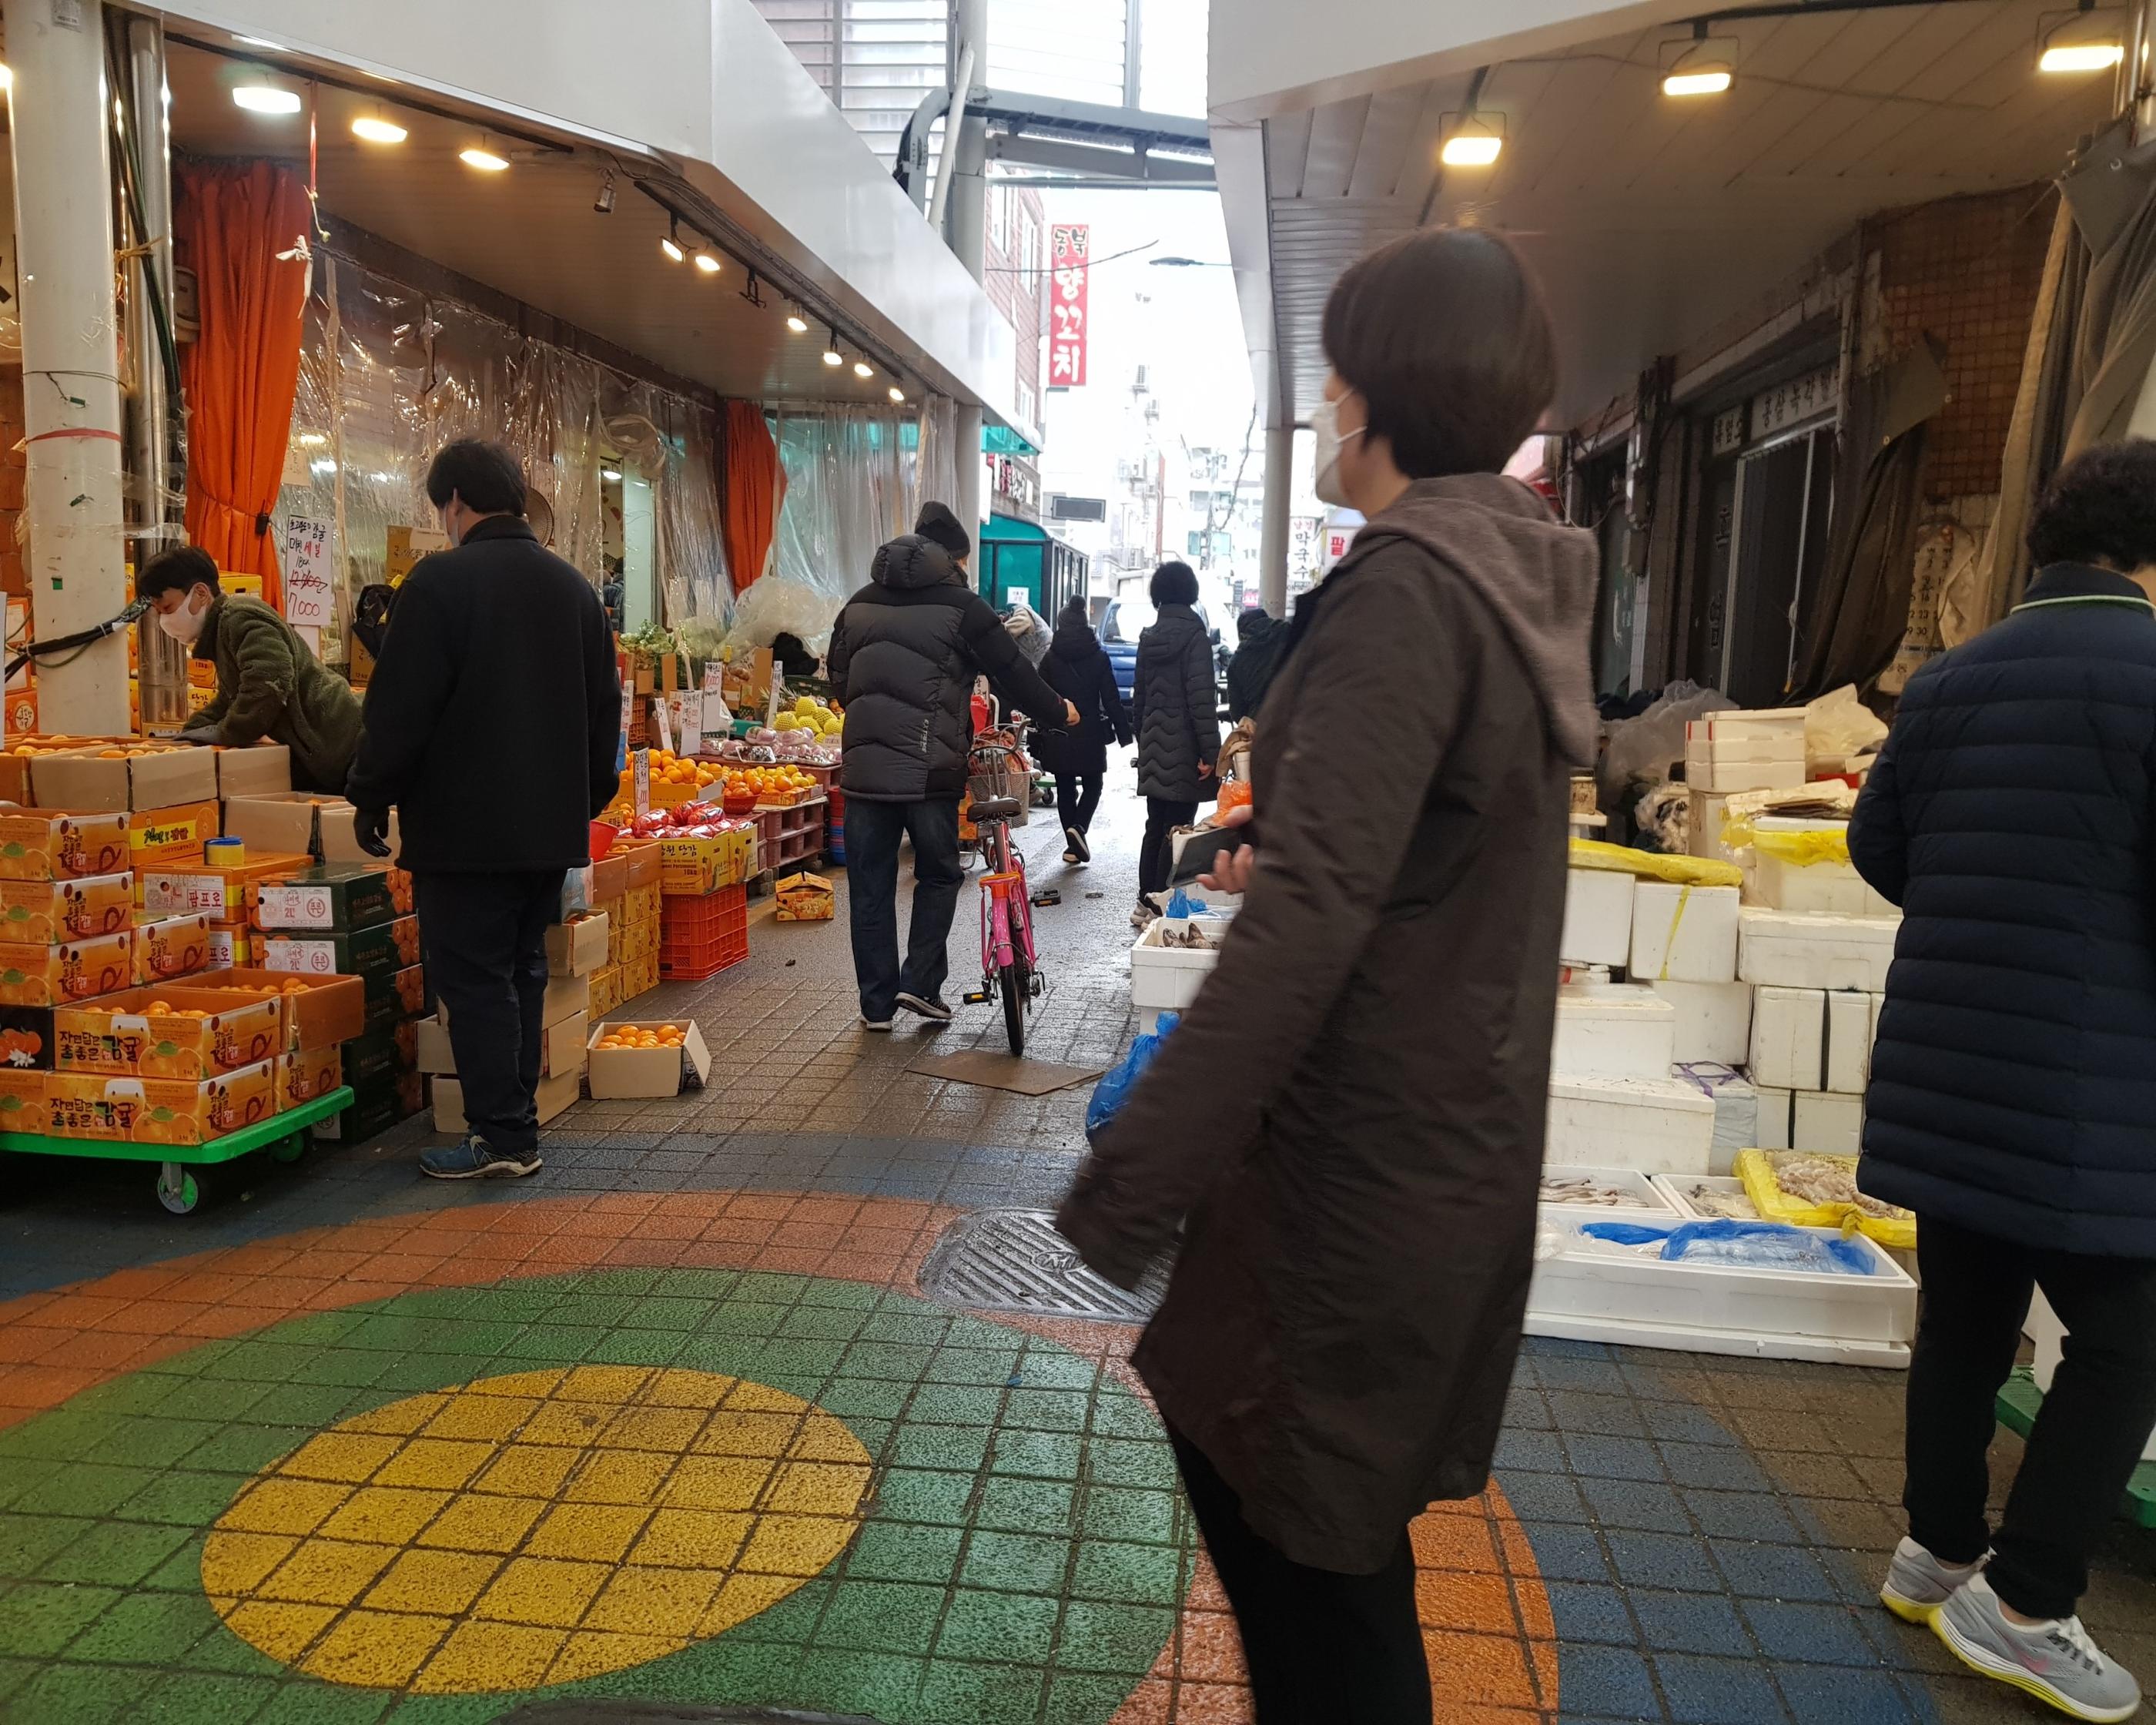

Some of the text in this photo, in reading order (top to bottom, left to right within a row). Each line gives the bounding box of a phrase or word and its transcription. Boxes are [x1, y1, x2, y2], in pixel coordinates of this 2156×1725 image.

[1054, 228, 1086, 256] 동북
[1053, 262, 1085, 384] 양꼬치
[303, 540, 320, 558] 세일
[1293, 531, 1311, 581] 막국수
[190, 693, 209, 706] 단감
[678, 844, 697, 856] 단감
[189, 889, 222, 908] 팜프로
[102, 1034, 141, 1063] 감귤
[95, 1100, 136, 1128] 감귤
